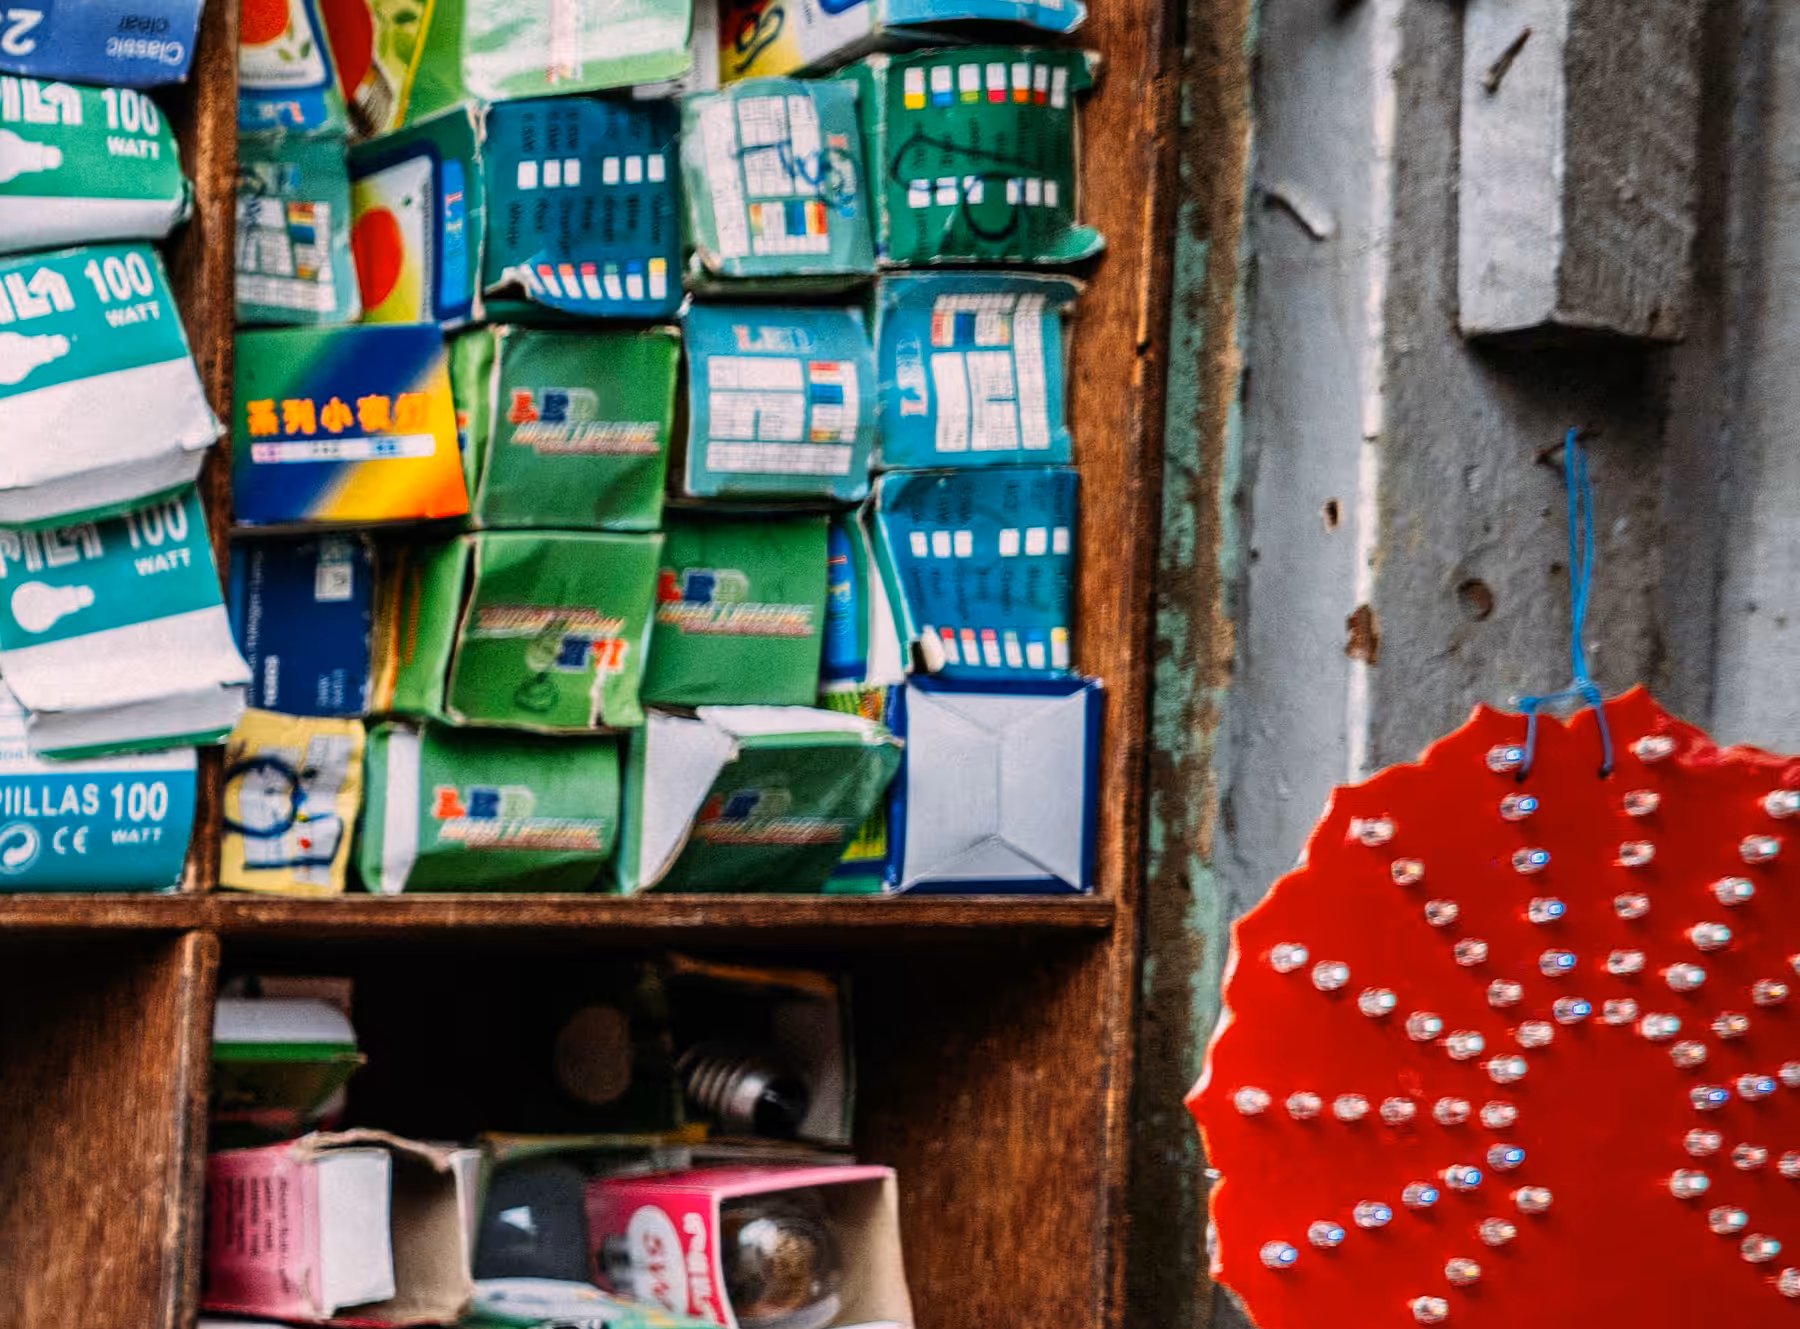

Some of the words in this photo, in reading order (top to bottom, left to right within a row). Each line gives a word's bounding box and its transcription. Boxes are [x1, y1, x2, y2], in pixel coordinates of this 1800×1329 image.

[115, 15, 169, 36] clear
[106, 36, 184, 66] Classic
[101, 87, 160, 136] 100
[106, 136, 160, 161] WATT
[84, 251, 155, 302] 100
[104, 300, 160, 329] WATT
[134, 547, 191, 577] WATT
[110, 781, 168, 821] 100
[111, 827, 163, 845] WATT
